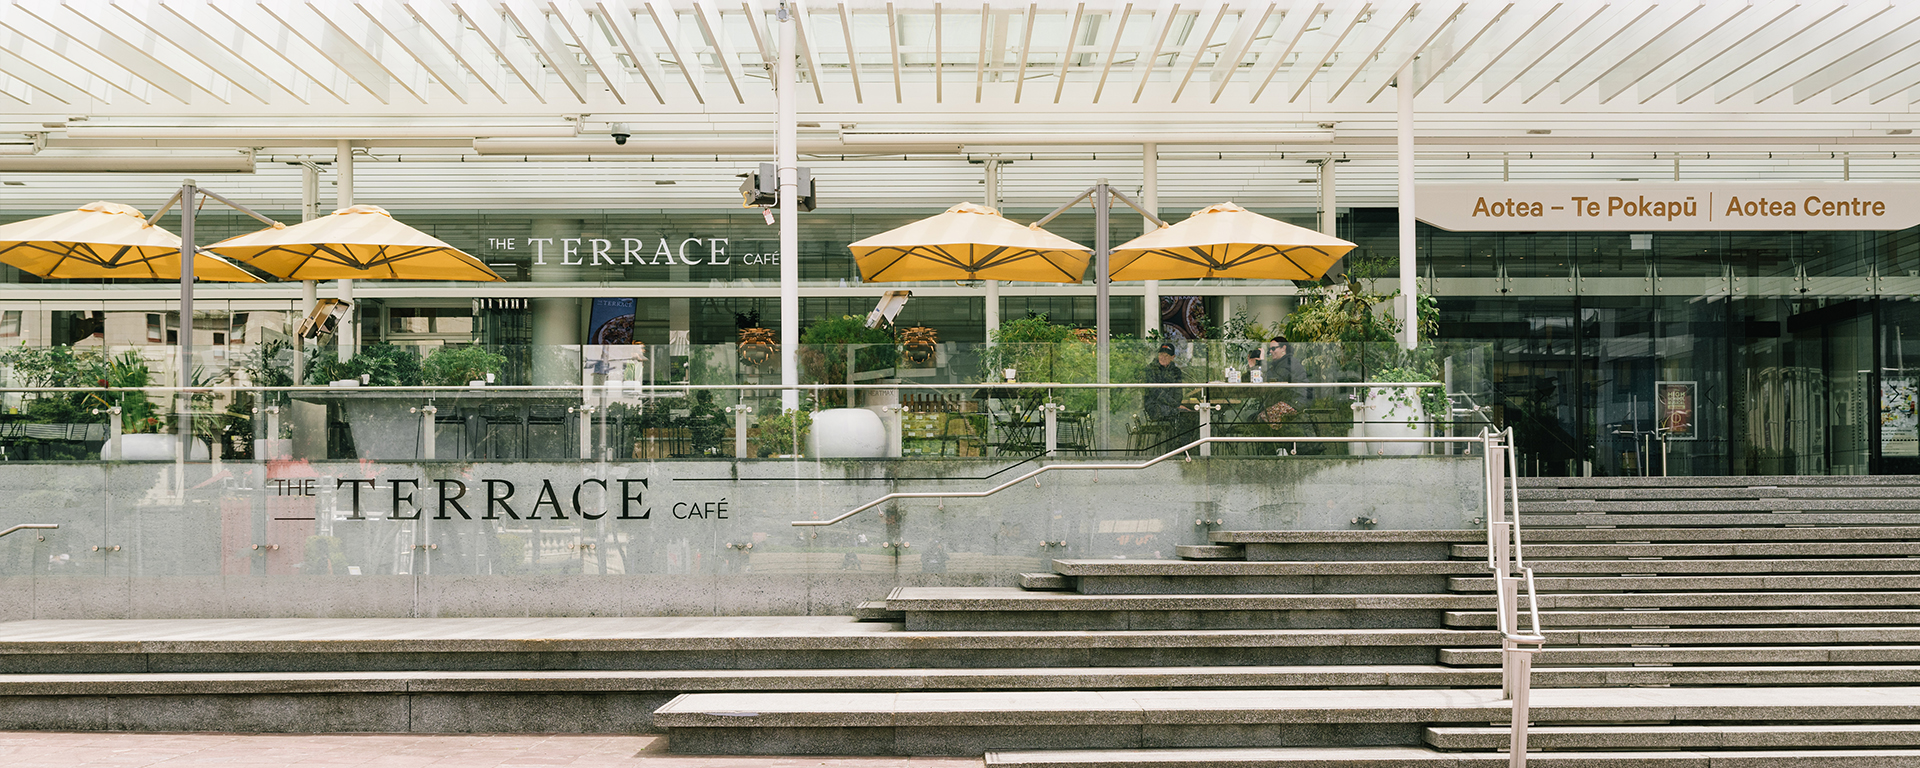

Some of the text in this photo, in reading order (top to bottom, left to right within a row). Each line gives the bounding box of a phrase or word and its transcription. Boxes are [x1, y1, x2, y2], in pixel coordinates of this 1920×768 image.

[1472, 196, 1544, 218] Aotea
[1572, 196, 1601, 217] Te
[1607, 195, 1697, 222] Pokapū
[1725, 196, 1797, 218] Aotea
[1803, 195, 1886, 217] Centre
[488, 237, 780, 266] THE TERRACE CAFÉ
[274, 477, 729, 521] THE TERRACE CAFÉ
